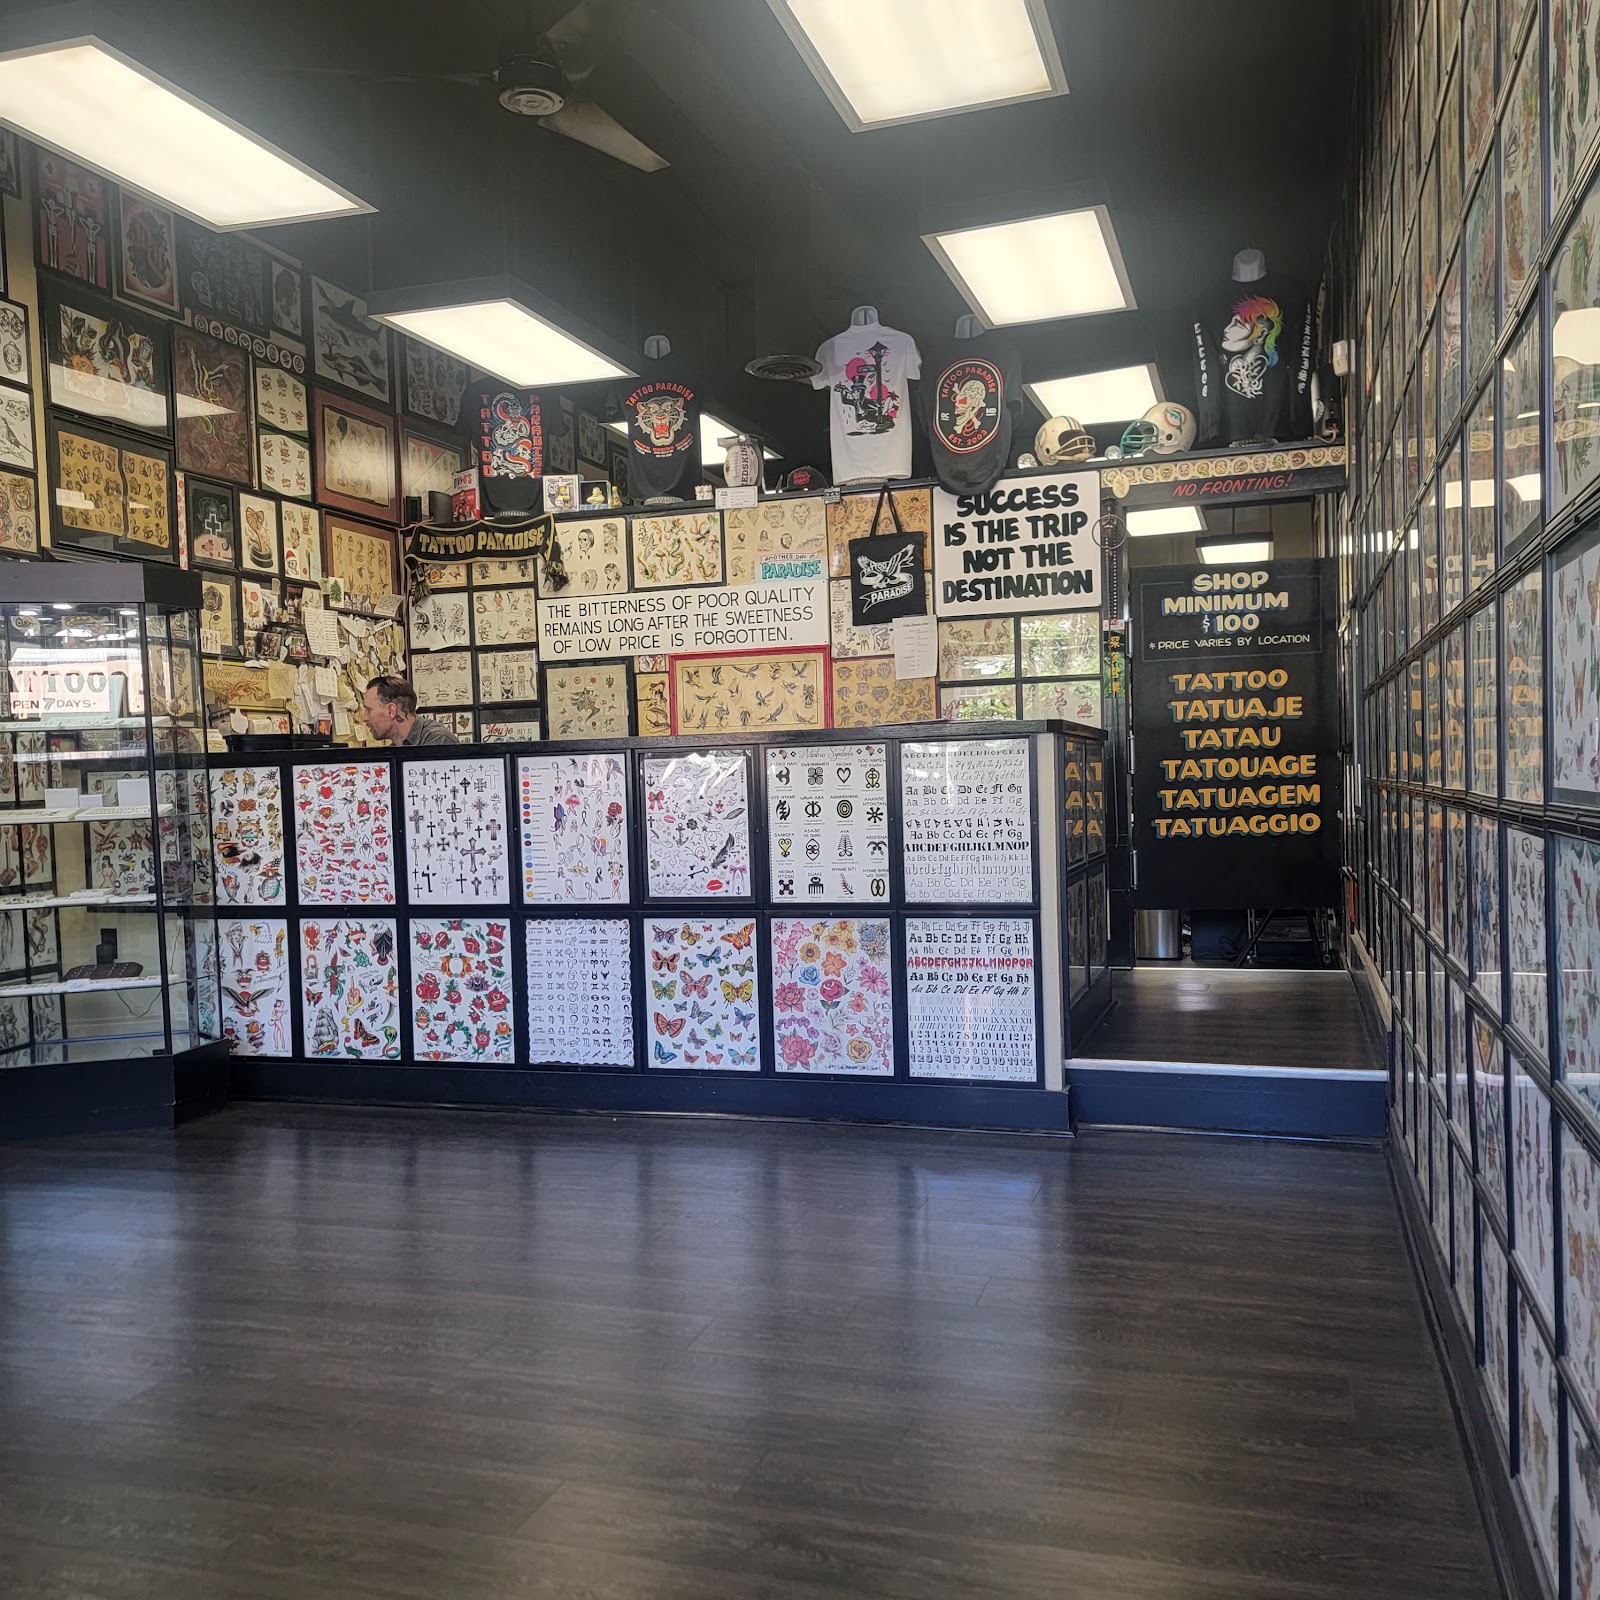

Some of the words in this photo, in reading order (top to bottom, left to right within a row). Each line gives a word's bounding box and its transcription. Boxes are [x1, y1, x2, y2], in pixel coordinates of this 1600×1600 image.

[625, 384, 654, 407] TATTOO
[656, 382, 694, 401] PARADISE
[942, 369, 963, 398] TATTOO
[965, 367, 996, 393] PARADISE
[480, 394, 494, 477] TATTOO
[529, 394, 543, 478] PARADISE
[966, 430, 988, 446] 2003
[1172, 483, 1197, 497] NO
[1200, 473, 1294, 495] FRONTING!
[956, 484, 1079, 518] SUCCESS
[420, 533, 475, 555] TATTOO
[477, 524, 546, 550] PARADISE
[944, 522, 967, 547] IS
[972, 518, 1020, 544] THE
[1025, 511, 1088, 539] TRIP
[762, 560, 821, 580] PARADISE
[962, 547, 1016, 574] NOT
[1020, 542, 1074, 568] THE
[870, 582, 912, 604] PARADISE
[942, 570, 1094, 604] DESTINATION
[1193, 571, 1270, 593] SHOP
[548, 604, 571, 619] THE
[578, 598, 666, 617] BITTERNESS
[672, 596, 692, 610] OF
[698, 592, 740, 609] POOR
[748, 586, 815, 606] QUALITY
[1162, 592, 1288, 615] MINIMUM
[544, 620, 602, 638] REMAINS
[608, 618, 644, 634] LONG
[647, 614, 689, 632] AFTER
[693, 612, 718, 628] THE
[725, 606, 814, 626] SWEETNESS
[553, 640, 572, 654] OF
[578, 638, 612, 653] LOW
[619, 634, 660, 650] PRICE
[670, 632, 685, 648] IS
[694, 626, 794, 646] FORGOTTEN.
[1194, 638, 1232, 648] VARIES
[1237, 637, 1252, 646] BY
[1258, 634, 1310, 645] LOCATION
[1170, 668, 1289, 692] TATTOO
[42, 698, 56, 711] 7
[1170, 696, 1303, 721] TATUAJE
[484, 722, 514, 737] You're
[1182, 726, 1282, 750] TATAU
[1162, 754, 1317, 780] TATOUAGE
[957, 796, 969, 805] Dd
[975, 796, 986, 804] Ee
[992, 796, 1004, 804] Ff
[1009, 796, 1022, 806] Gg
[1159, 784, 1321, 810] TATUAGEM
[910, 831, 922, 839] Aa
[927, 831, 939, 839] Bb
[943, 830, 955, 839] Cc
[958, 830, 972, 838] Dd
[976, 830, 988, 839] Ee
[993, 829, 1003, 840] Ff
[1008, 829, 1022, 840] Gg
[1154, 812, 1322, 837] TATUAGGIO
[909, 933, 922, 943] Aa
[926, 933, 938, 943] Bb
[941, 934, 952, 943] Cc
[955, 934, 968, 943] Dd
[971, 934, 981, 943] Ee
[985, 934, 996, 943] Ff
[1000, 934, 1012, 944] Gg
[1015, 934, 1028, 943] Hh
